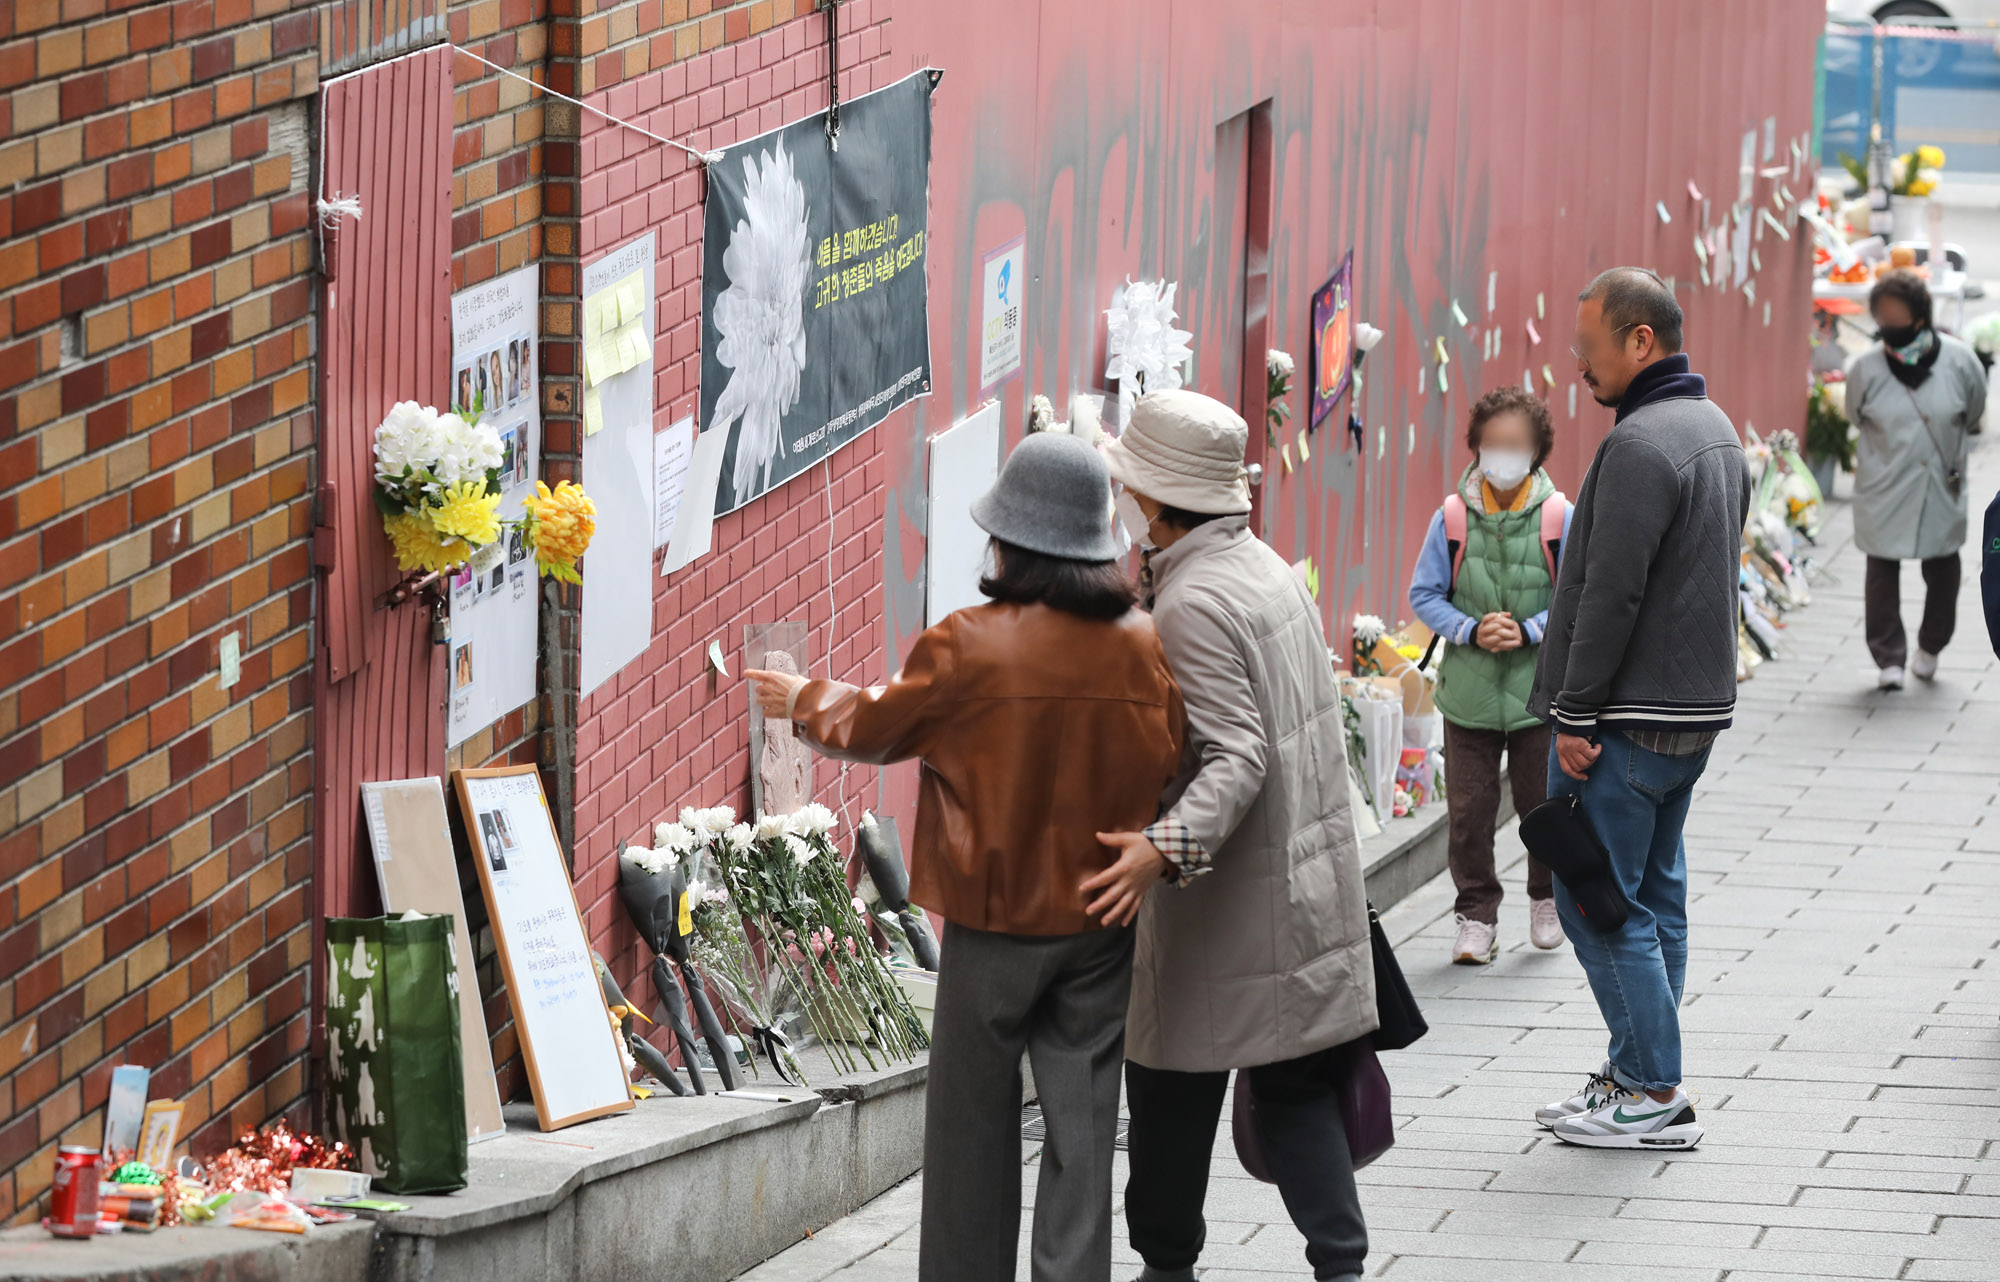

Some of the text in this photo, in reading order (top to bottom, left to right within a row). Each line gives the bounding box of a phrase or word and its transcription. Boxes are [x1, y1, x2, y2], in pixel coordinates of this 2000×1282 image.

[817, 232, 840, 269] 아픔을
[815, 272, 840, 309] 고귀한
[842, 259, 873, 299] 청춘들의
[875, 248, 896, 283] 죽음을
[986, 305, 1018, 341] CCTV 작동중
